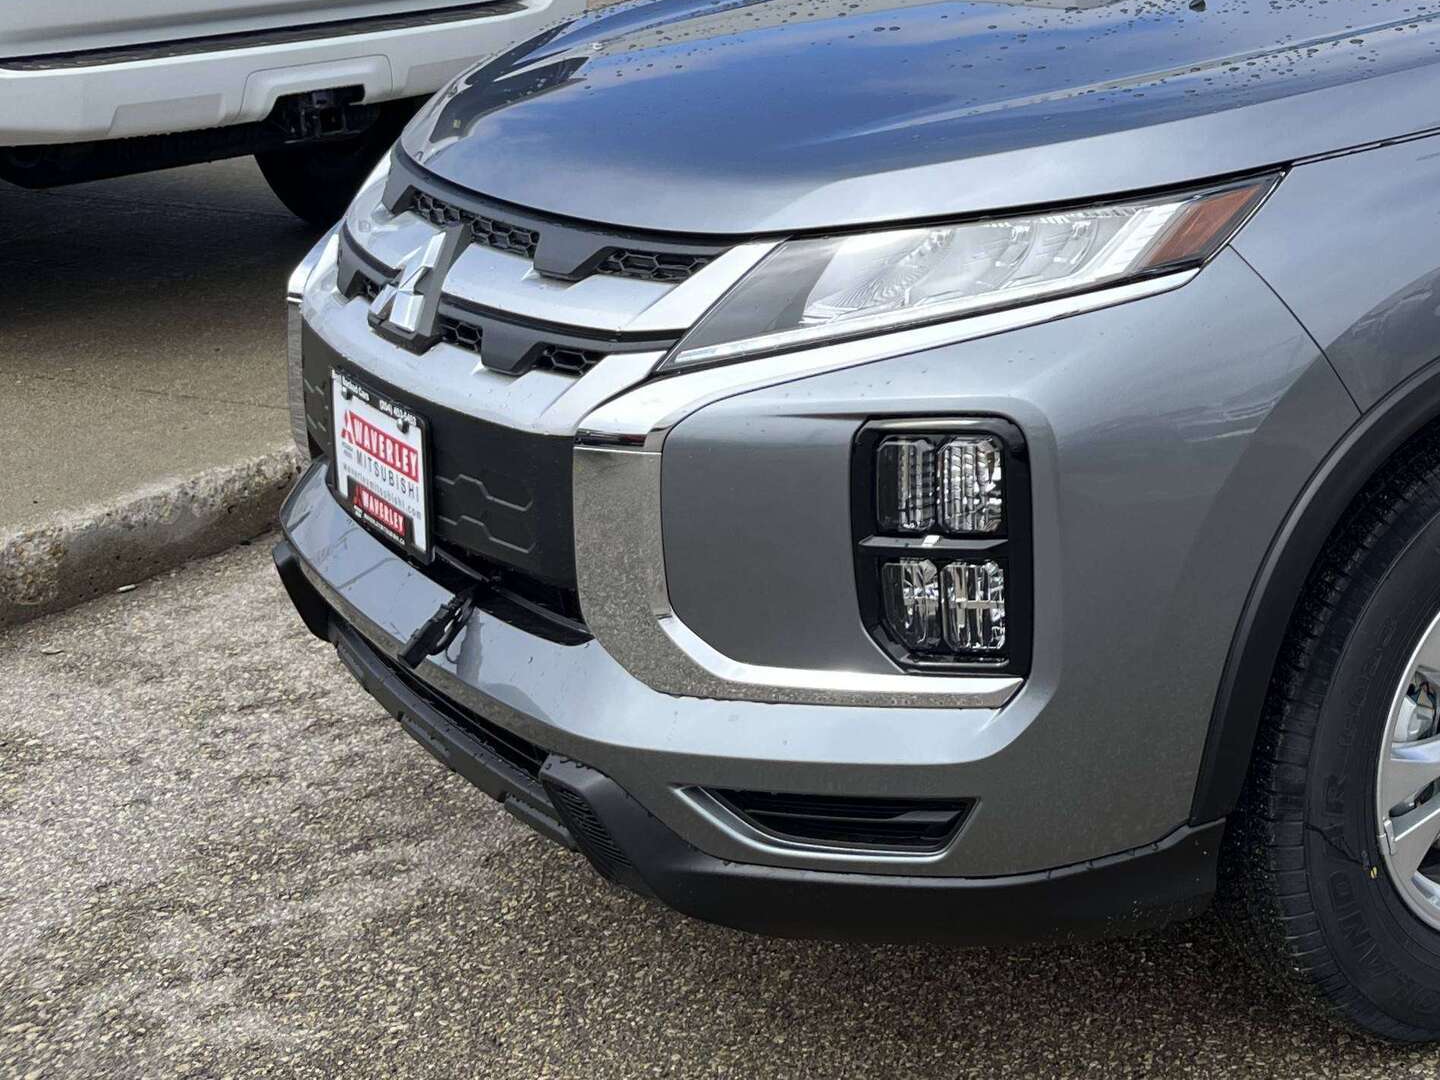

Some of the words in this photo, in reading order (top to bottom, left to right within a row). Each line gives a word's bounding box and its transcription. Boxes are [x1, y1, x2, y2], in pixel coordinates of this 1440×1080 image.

[352, 417, 419, 478] WAVERLEY
[356, 449, 420, 502] MITSUBISHI
[361, 489, 405, 535] WAVERLEY
